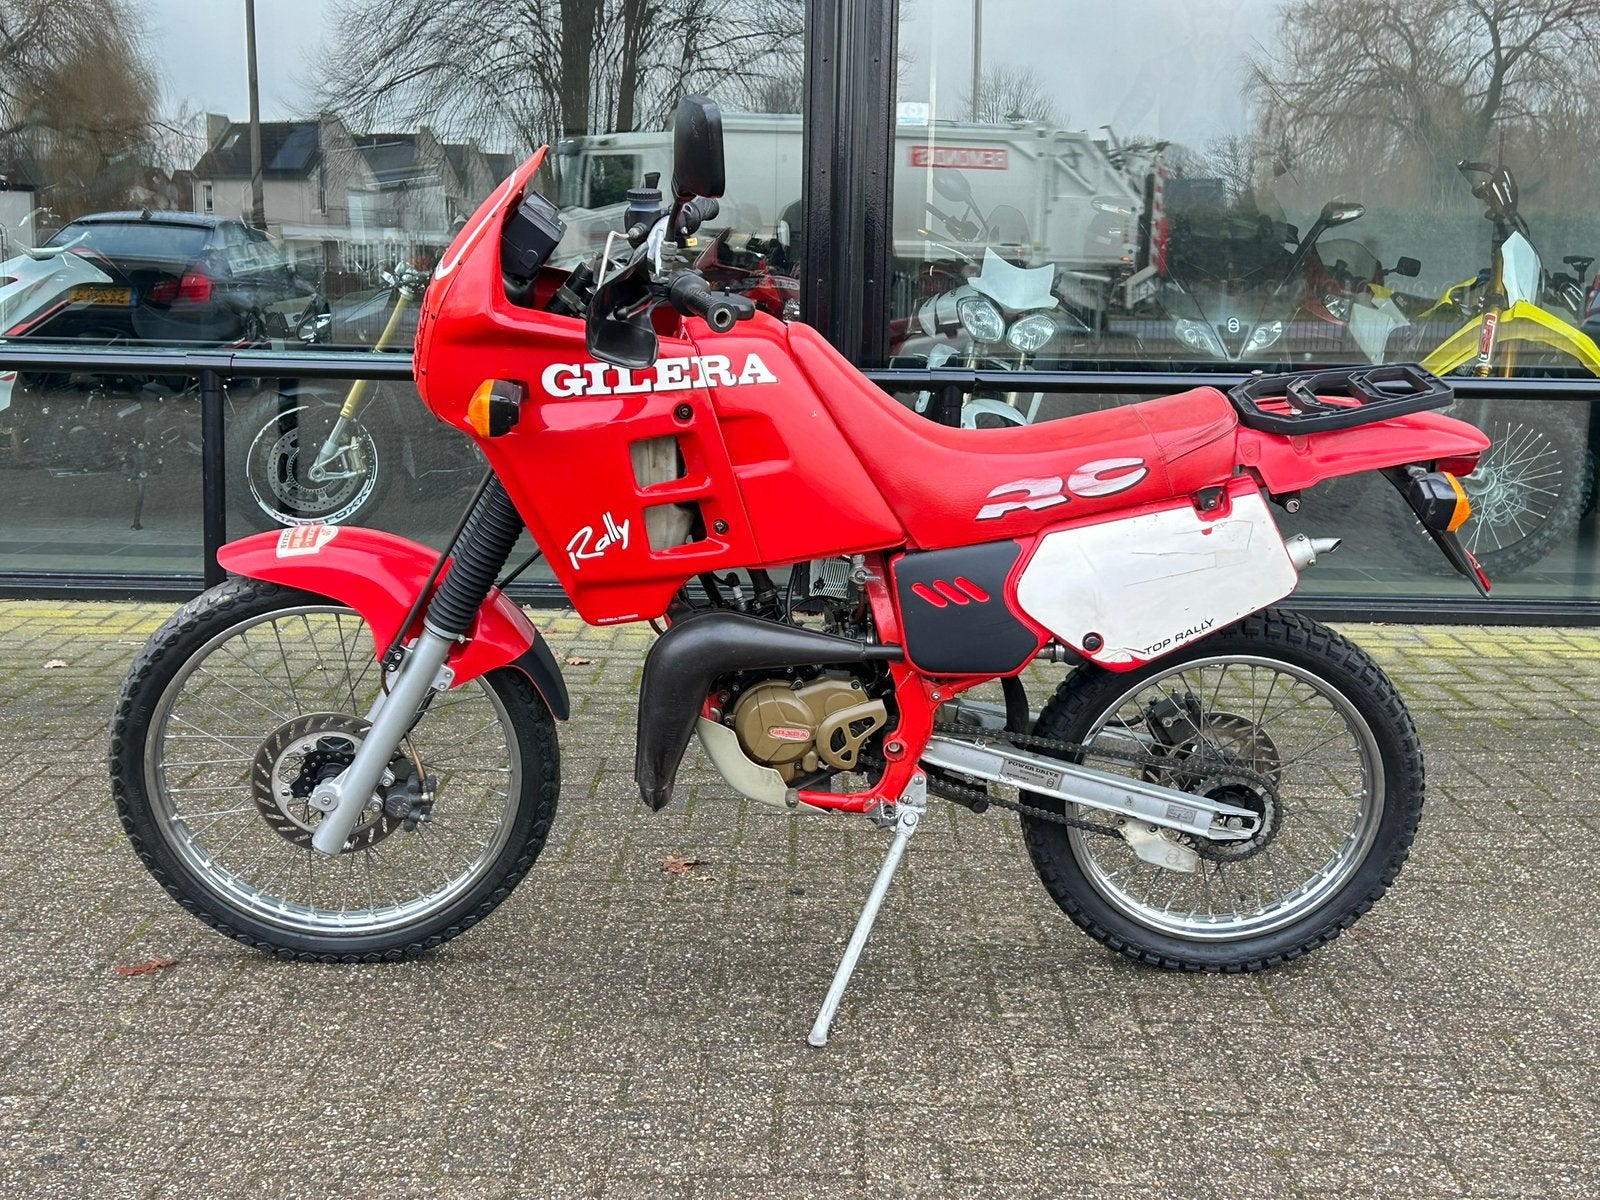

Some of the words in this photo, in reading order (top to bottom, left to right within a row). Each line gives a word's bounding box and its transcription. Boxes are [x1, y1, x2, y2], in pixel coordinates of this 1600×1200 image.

[541, 352, 779, 398] GILERA
[975, 457, 1151, 521] RC
[565, 511, 630, 570] Rally
[1144, 638, 1171, 655] TOP
[1174, 617, 1214, 642] RALLY
[1008, 760, 1035, 771] POWER
[1035, 767, 1060, 778] DRIVE
